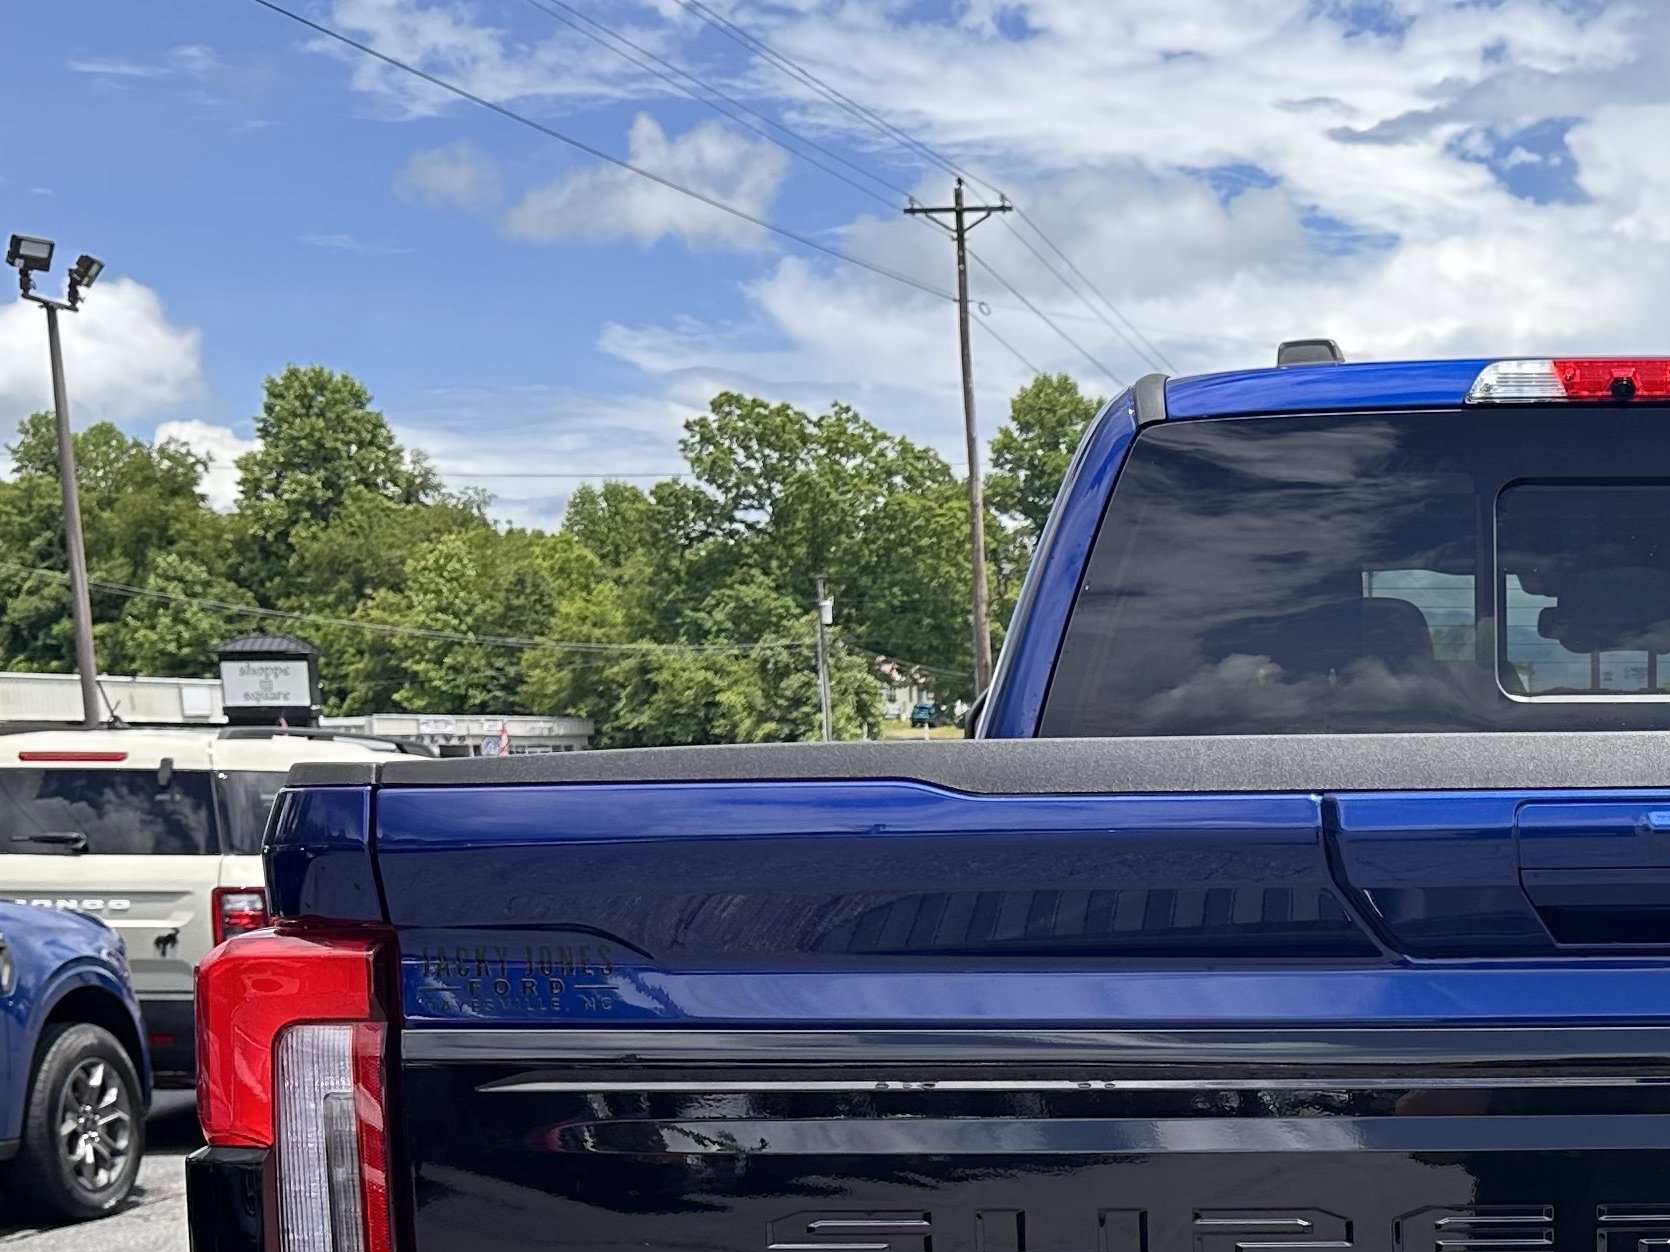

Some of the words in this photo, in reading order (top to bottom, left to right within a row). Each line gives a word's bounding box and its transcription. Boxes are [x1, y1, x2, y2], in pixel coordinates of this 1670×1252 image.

[14, 899, 131, 911] ONCO
[421, 944, 508, 978] JACKY
[524, 943, 615, 978] JONES
[467, 977, 567, 997] FORD
[583, 996, 614, 1012] NC
